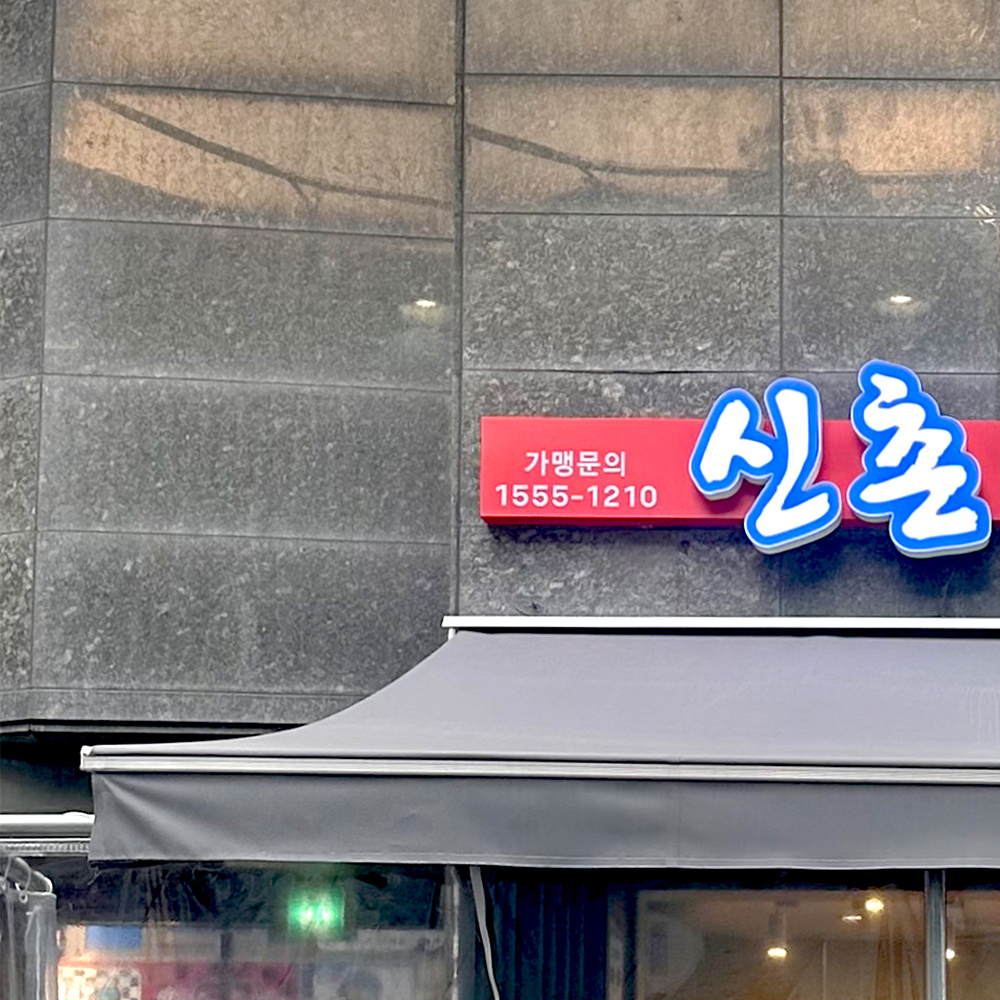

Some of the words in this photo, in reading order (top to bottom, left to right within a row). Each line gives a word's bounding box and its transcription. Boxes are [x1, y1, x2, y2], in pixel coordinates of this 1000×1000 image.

[524, 450, 626, 478] 가맹문의
[692, 362, 990, 555] 신촌
[495, 484, 658, 508] 1555-1210
